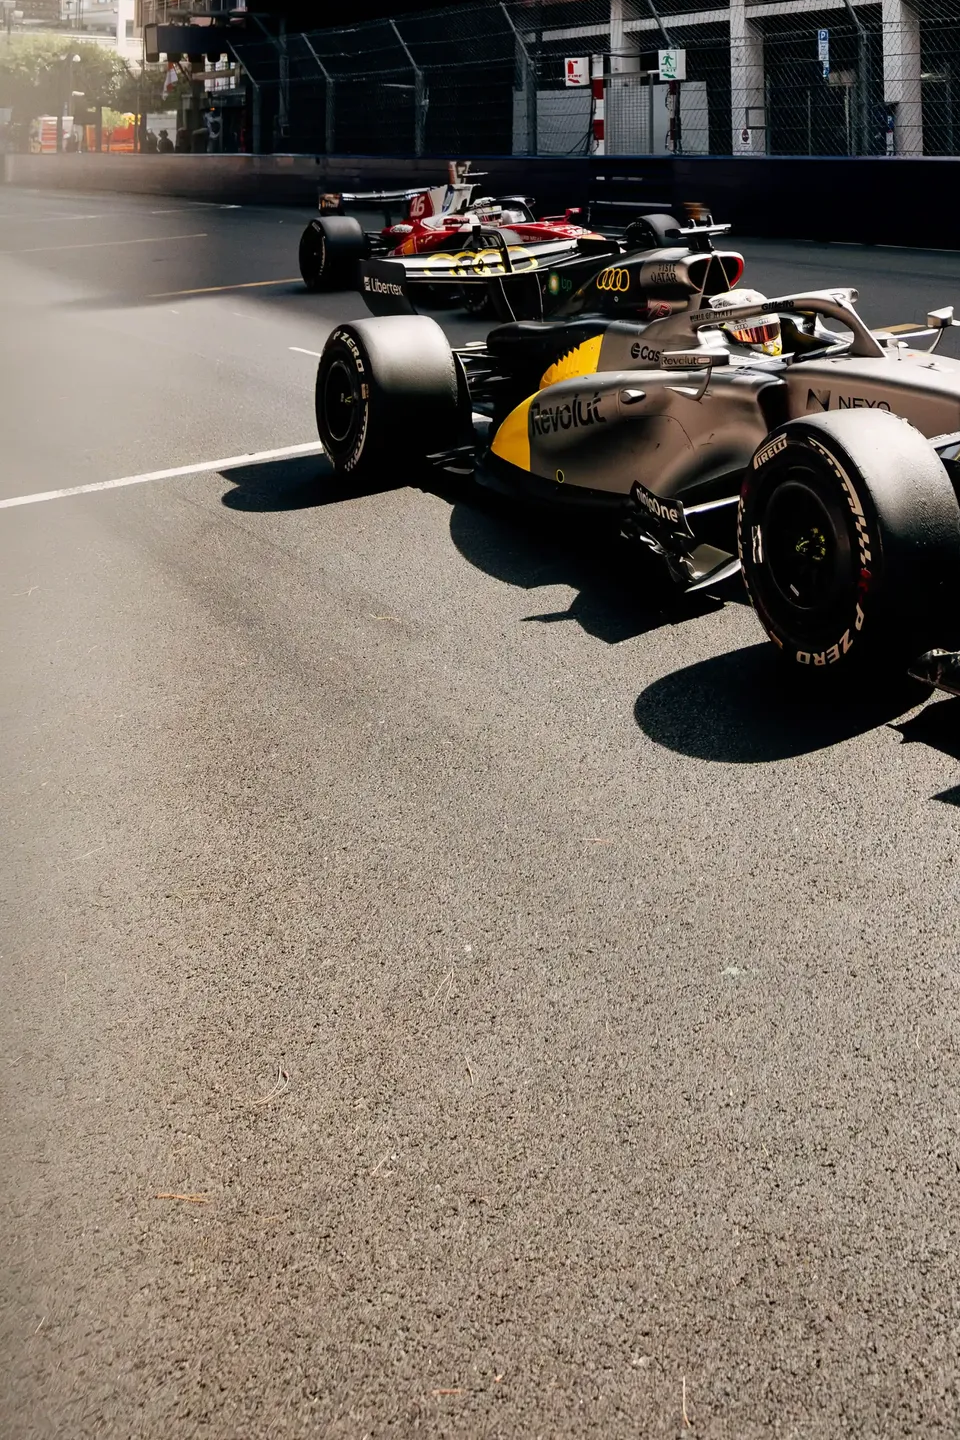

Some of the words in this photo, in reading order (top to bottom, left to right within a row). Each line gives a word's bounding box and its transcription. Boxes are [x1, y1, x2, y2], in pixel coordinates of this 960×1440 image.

[410, 195, 426, 217] 16
[370, 277, 404, 297] Libertex
[651, 271, 678, 285] QATAR
[340, 332, 365, 373] ZERO
[661, 355, 697, 366] Revolut
[531, 392, 607, 436] Revolut
[753, 432, 788, 471] PIRELLI
[795, 628, 853, 666] ZERO
